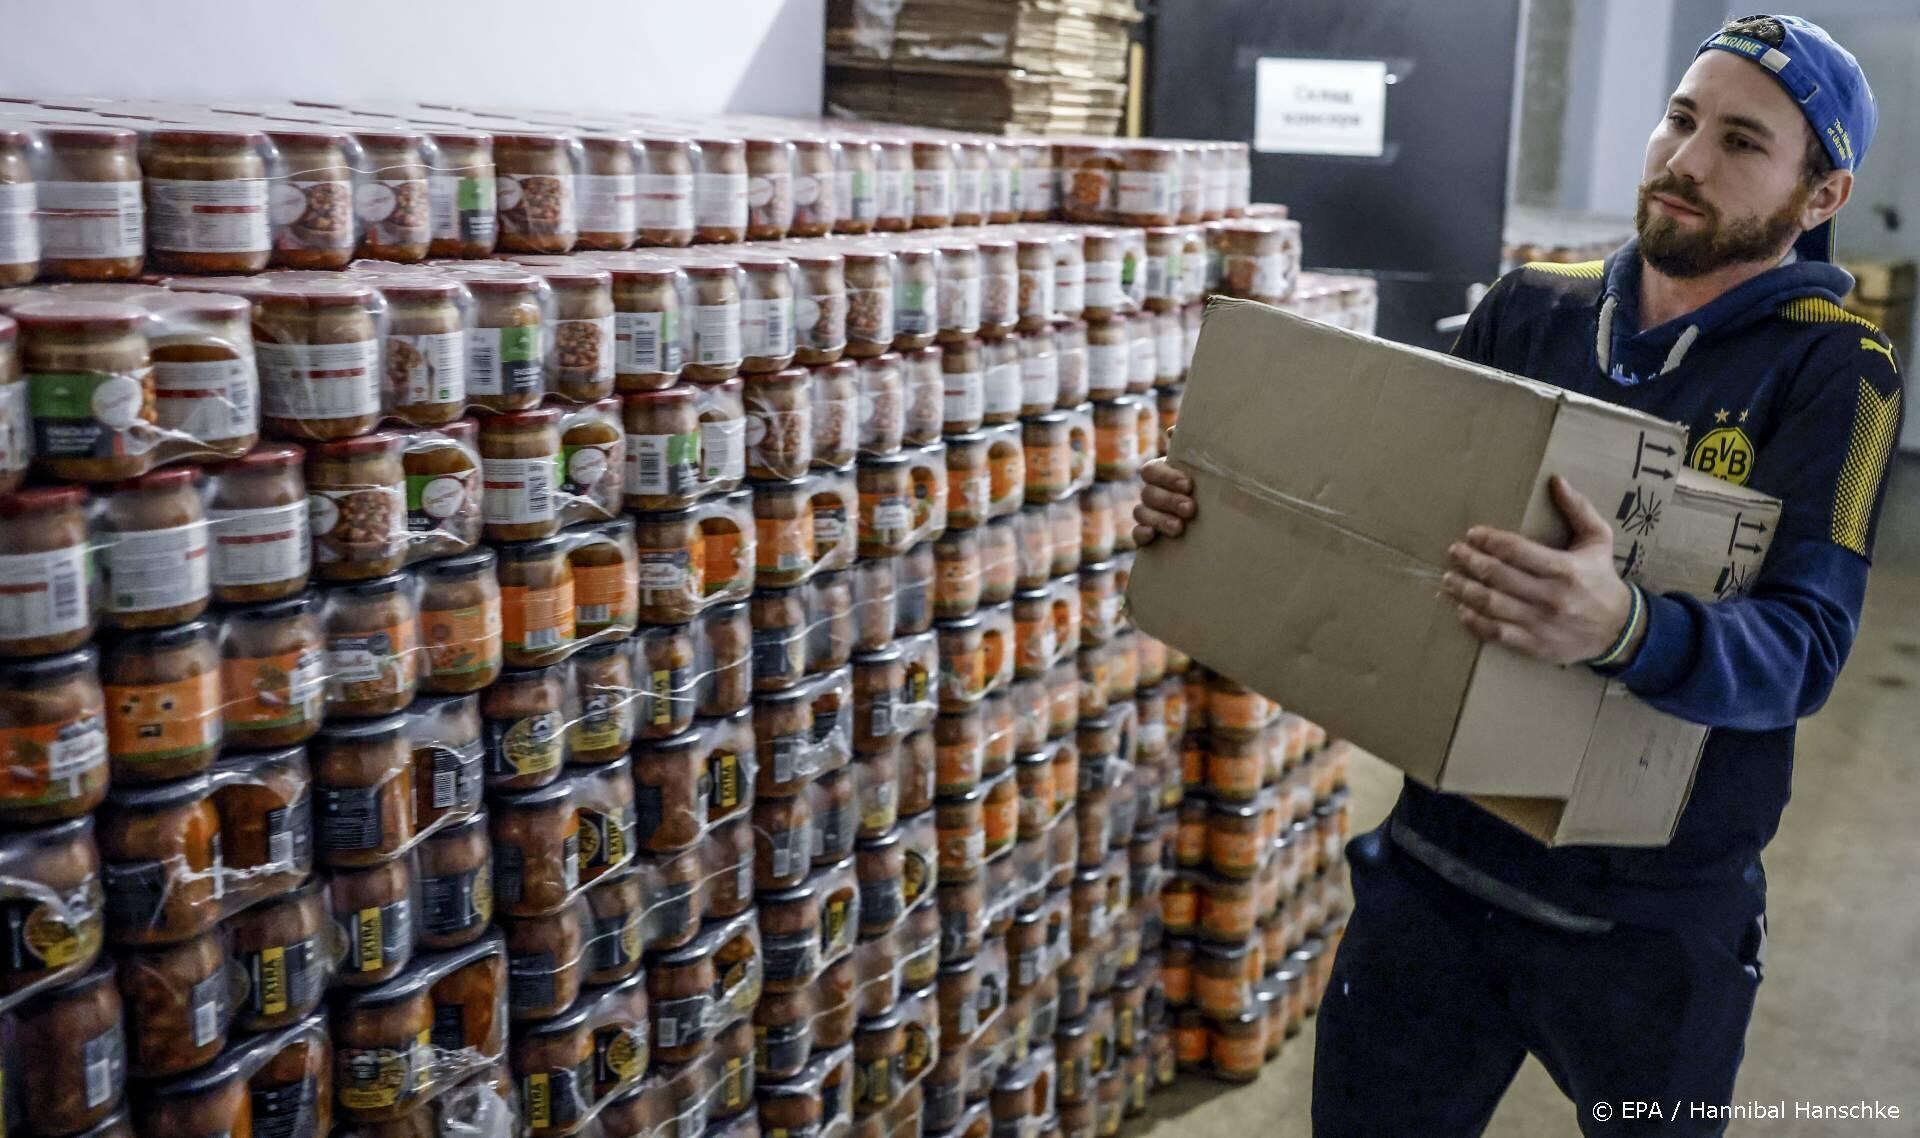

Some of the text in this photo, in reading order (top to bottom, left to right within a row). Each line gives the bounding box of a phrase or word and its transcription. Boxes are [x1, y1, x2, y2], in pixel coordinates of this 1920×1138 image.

[1697, 437, 1748, 476] BVB
[360, 917, 376, 962] EXTRA
[263, 959, 279, 1005] EXTRA
